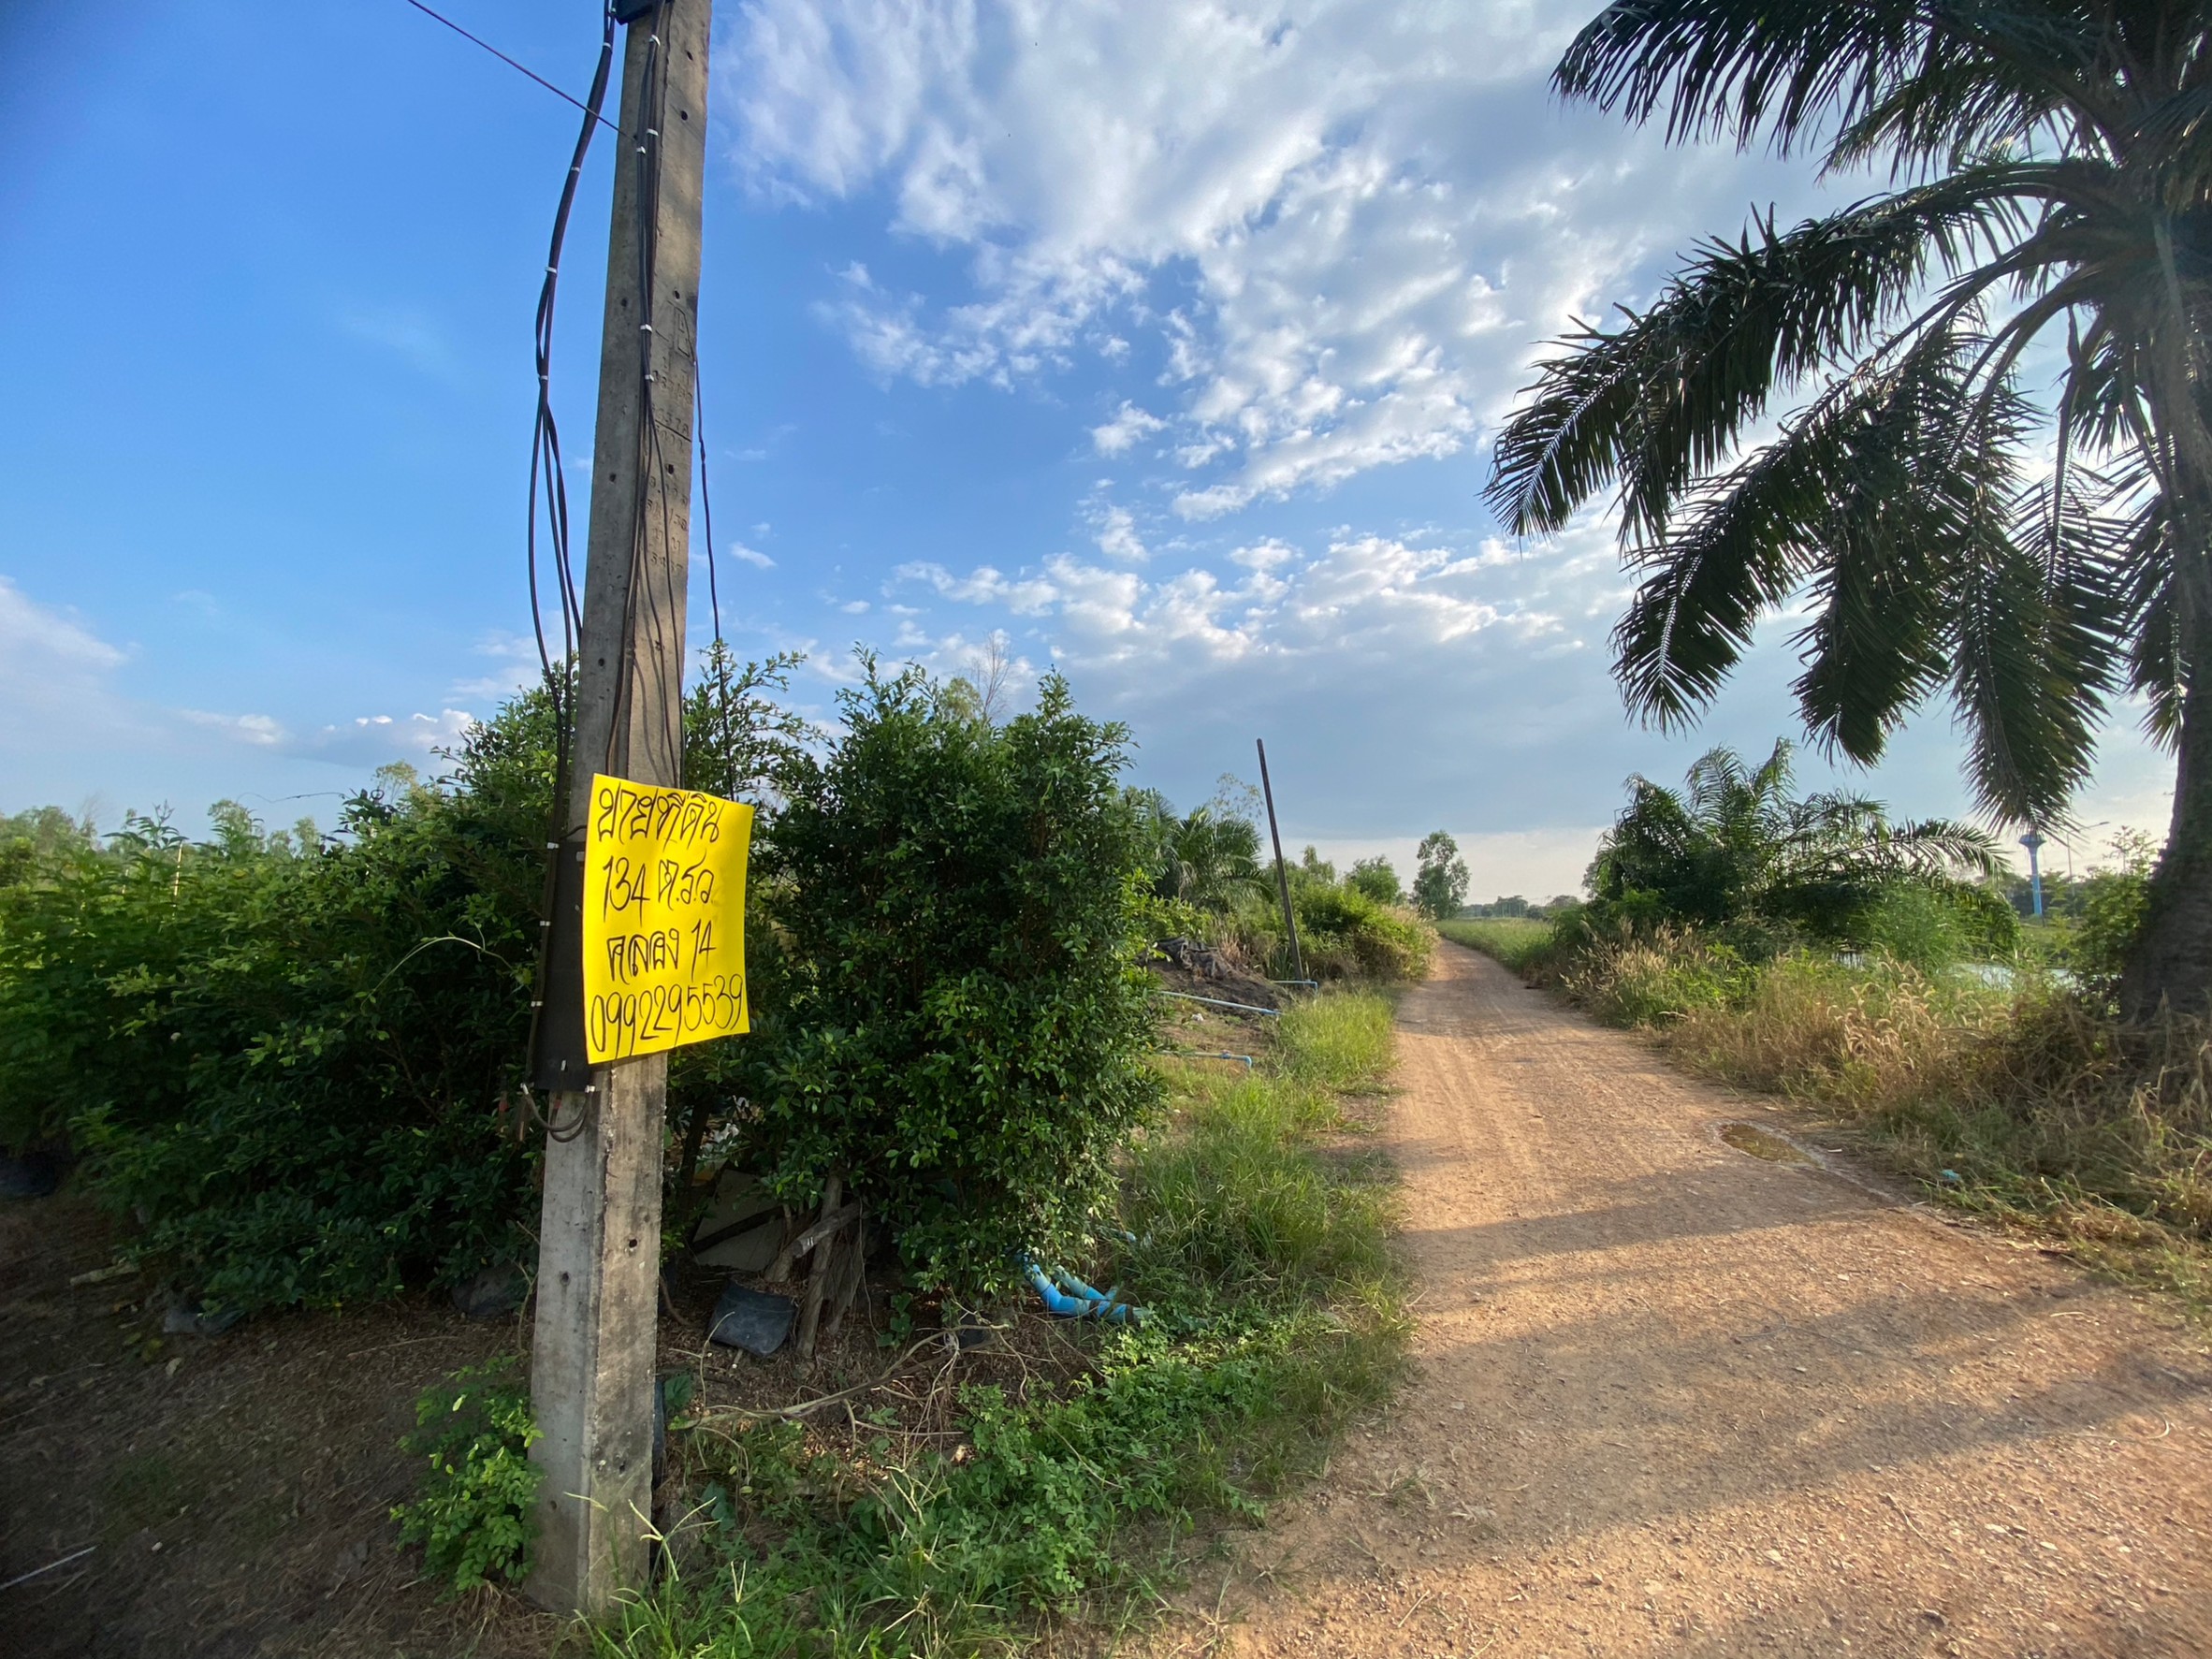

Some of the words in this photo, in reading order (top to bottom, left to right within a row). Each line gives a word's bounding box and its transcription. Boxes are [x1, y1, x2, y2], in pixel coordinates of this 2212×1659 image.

[597, 781, 726, 852] ขายที่ดิน
[602, 855, 650, 927] 134
[606, 927, 679, 985] คลอง
[691, 919, 717, 983] 14
[590, 973, 743, 1059] 0992295539
